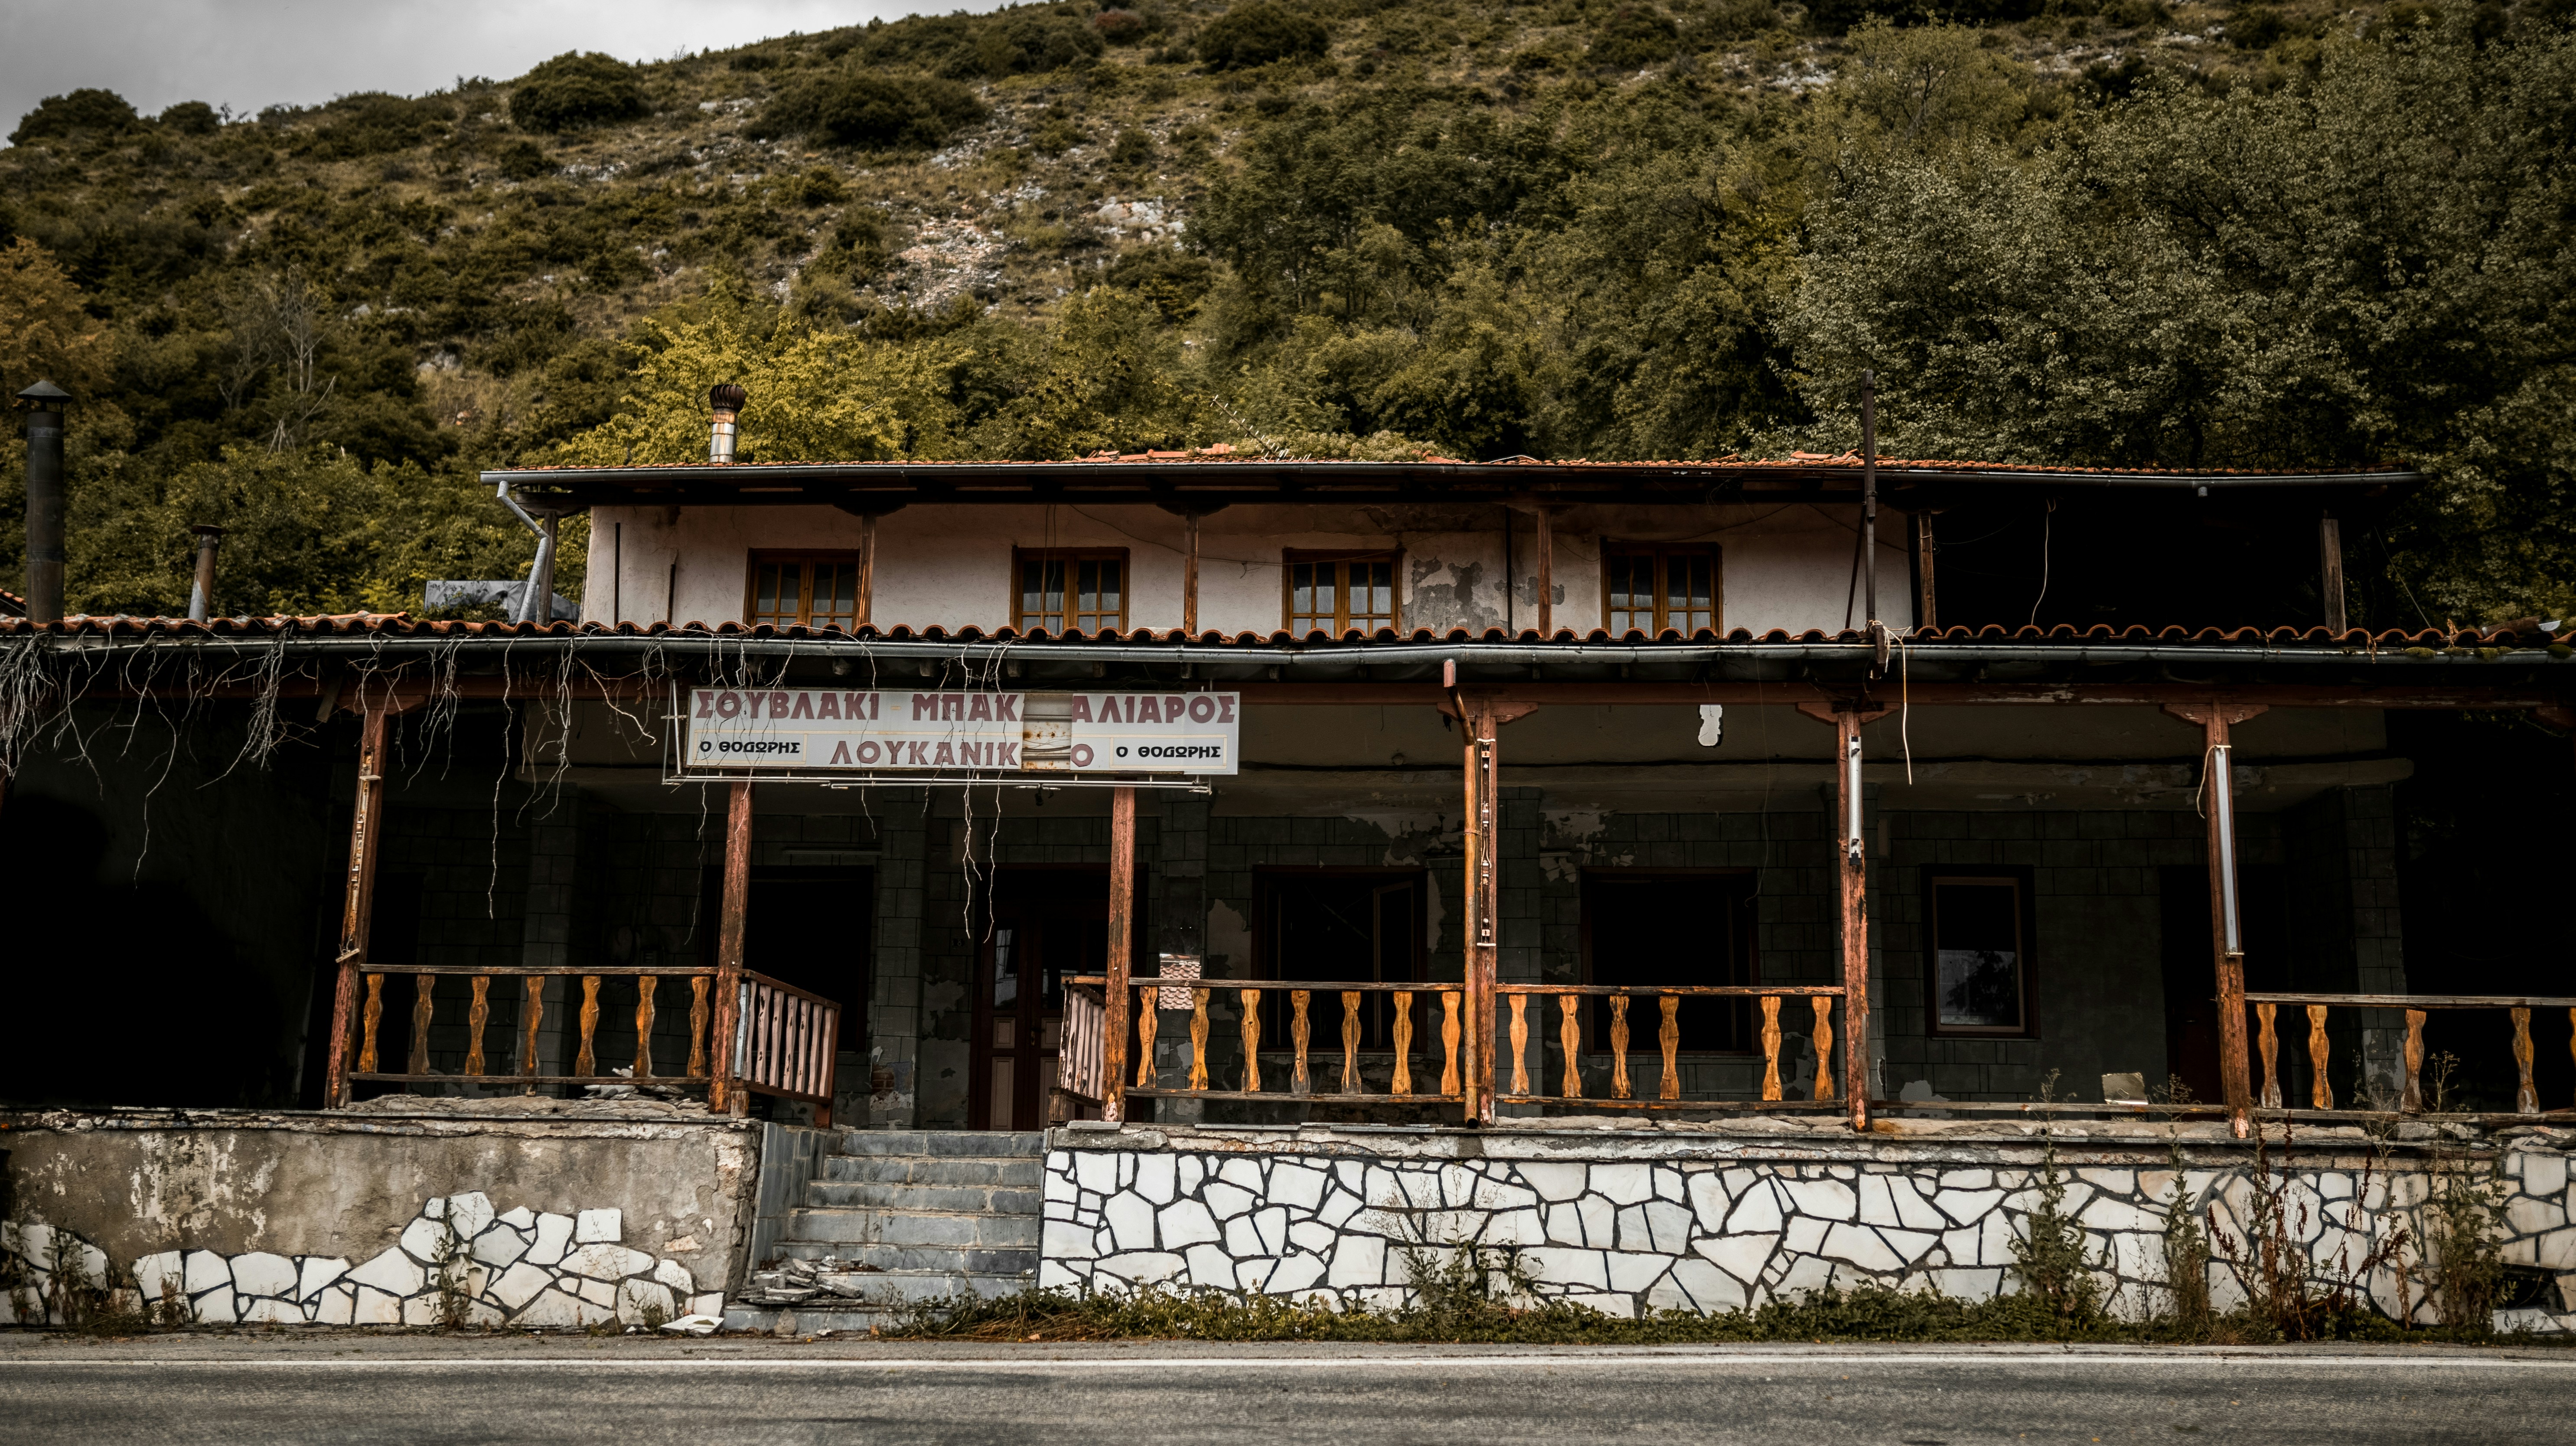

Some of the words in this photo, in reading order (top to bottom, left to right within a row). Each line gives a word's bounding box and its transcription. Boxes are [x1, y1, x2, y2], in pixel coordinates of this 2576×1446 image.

[695, 691, 880, 720] ΣΟΥΒΛΑΚΙ
[718, 741, 801, 754] ΘΟΔΩΡΗΣ
[1138, 746, 1221, 759] ΘΟΔΩΡΗΣ
